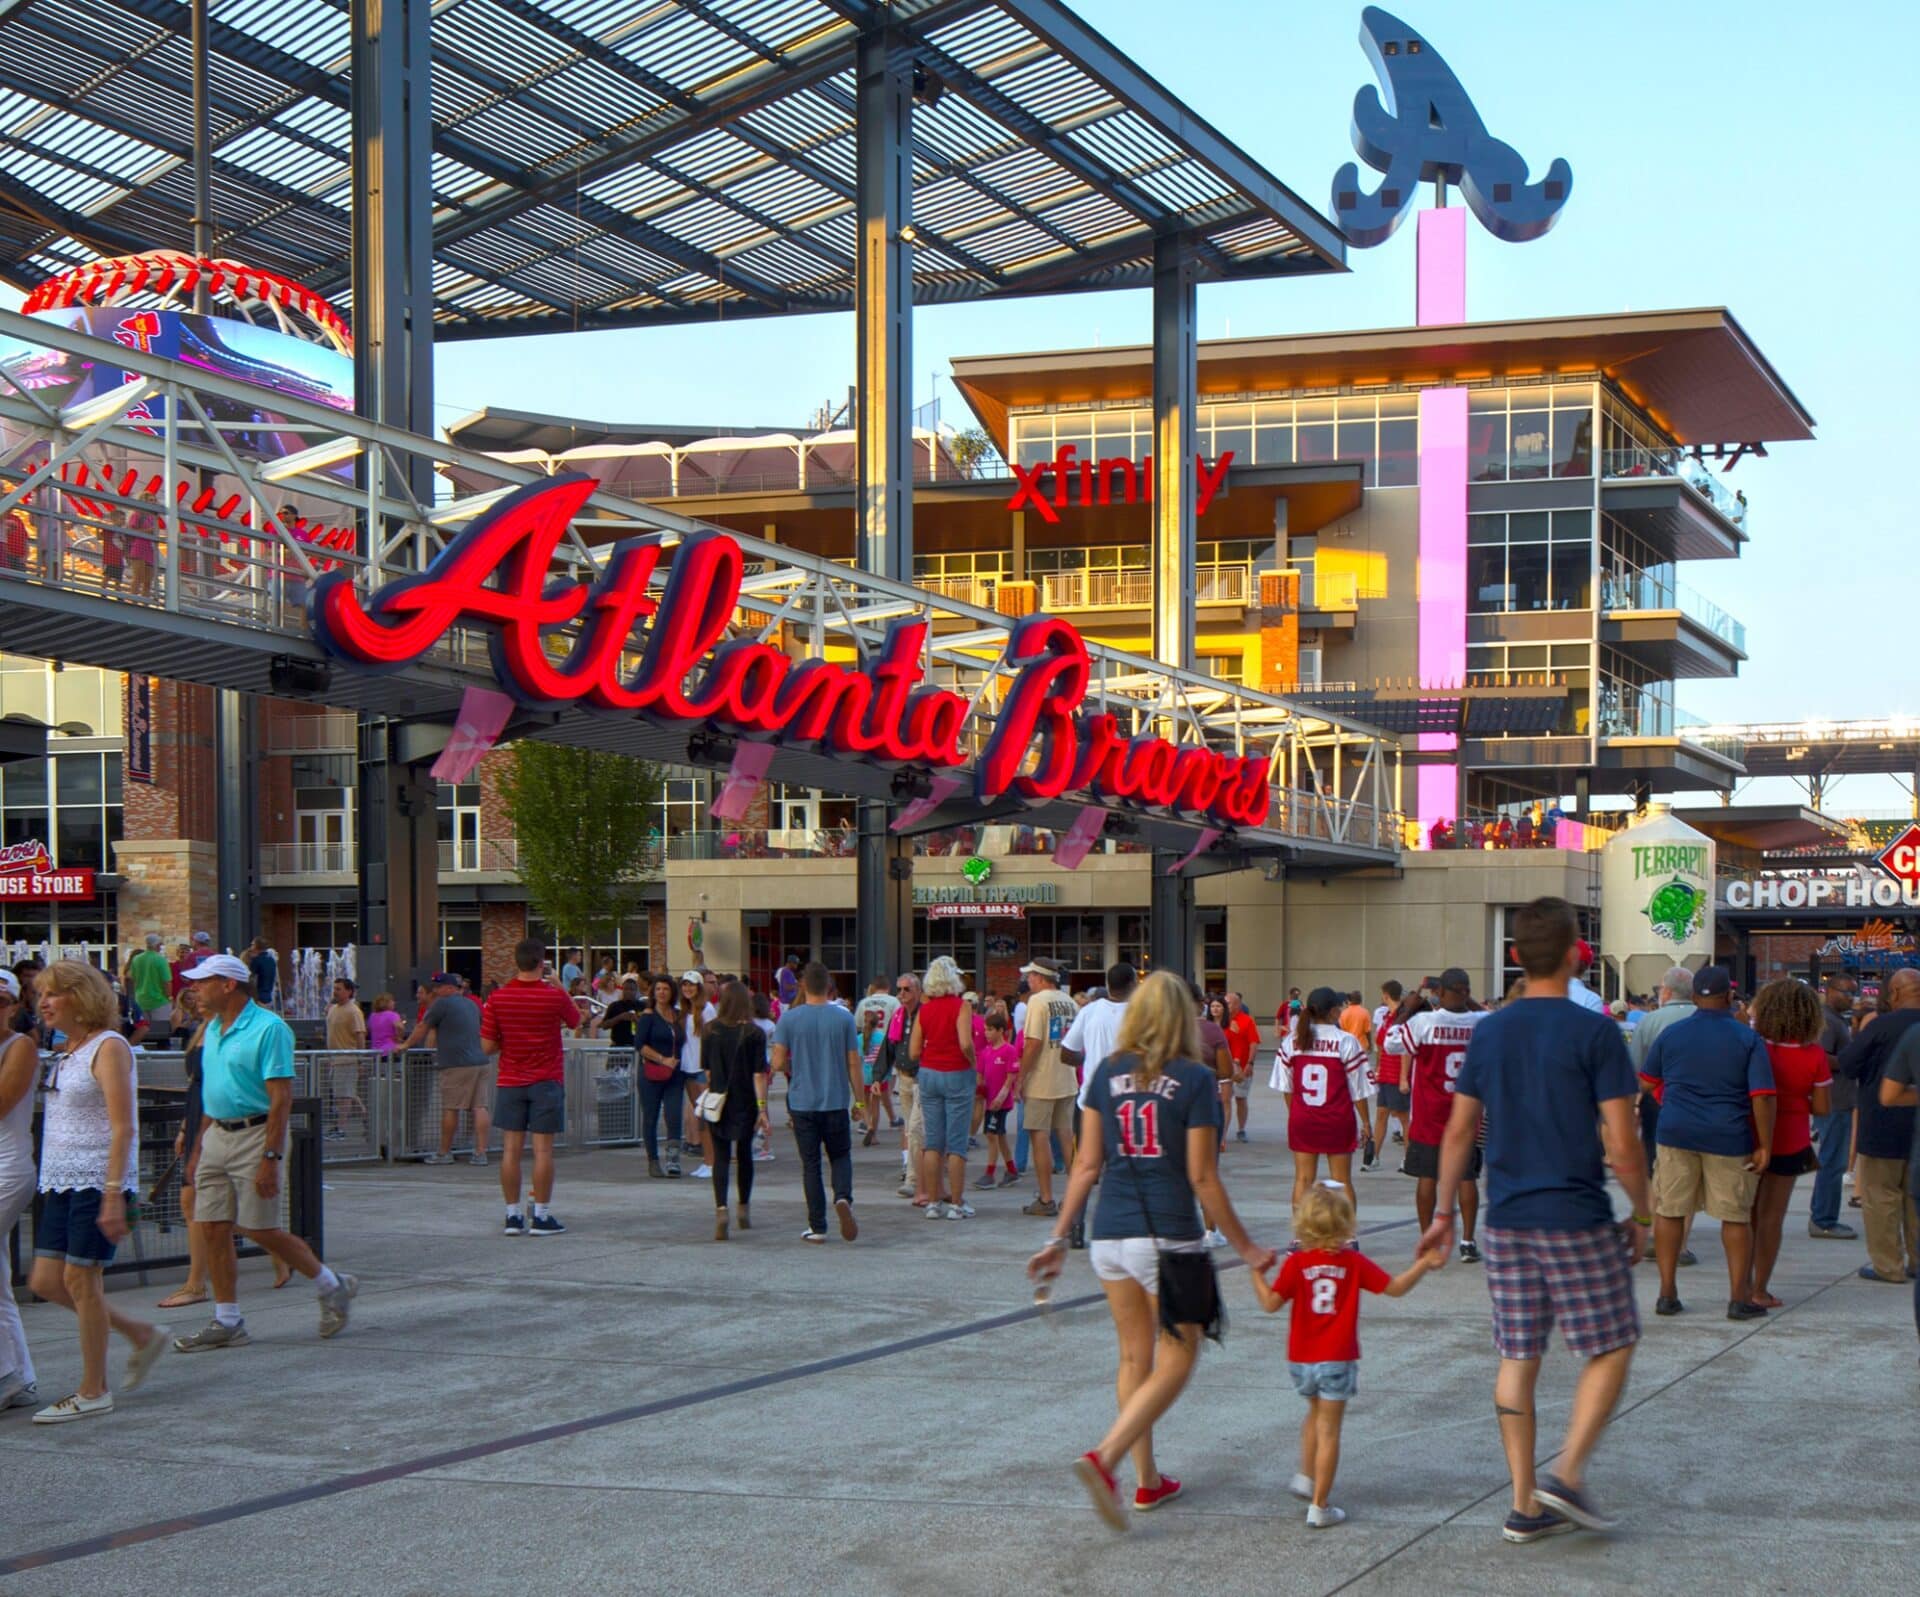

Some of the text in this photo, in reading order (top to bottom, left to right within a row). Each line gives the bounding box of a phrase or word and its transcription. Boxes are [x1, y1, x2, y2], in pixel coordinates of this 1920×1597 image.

[1007, 444, 1235, 523] xfiniy
[310, 472, 1271, 827] Atlanta Braves
[32, 875, 84, 895] STORE
[1726, 880, 1833, 908] CHOP
[1302, 1064, 1328, 1107] 9
[1115, 1099, 1163, 1158] 11
[1311, 1278, 1338, 1315] 8
